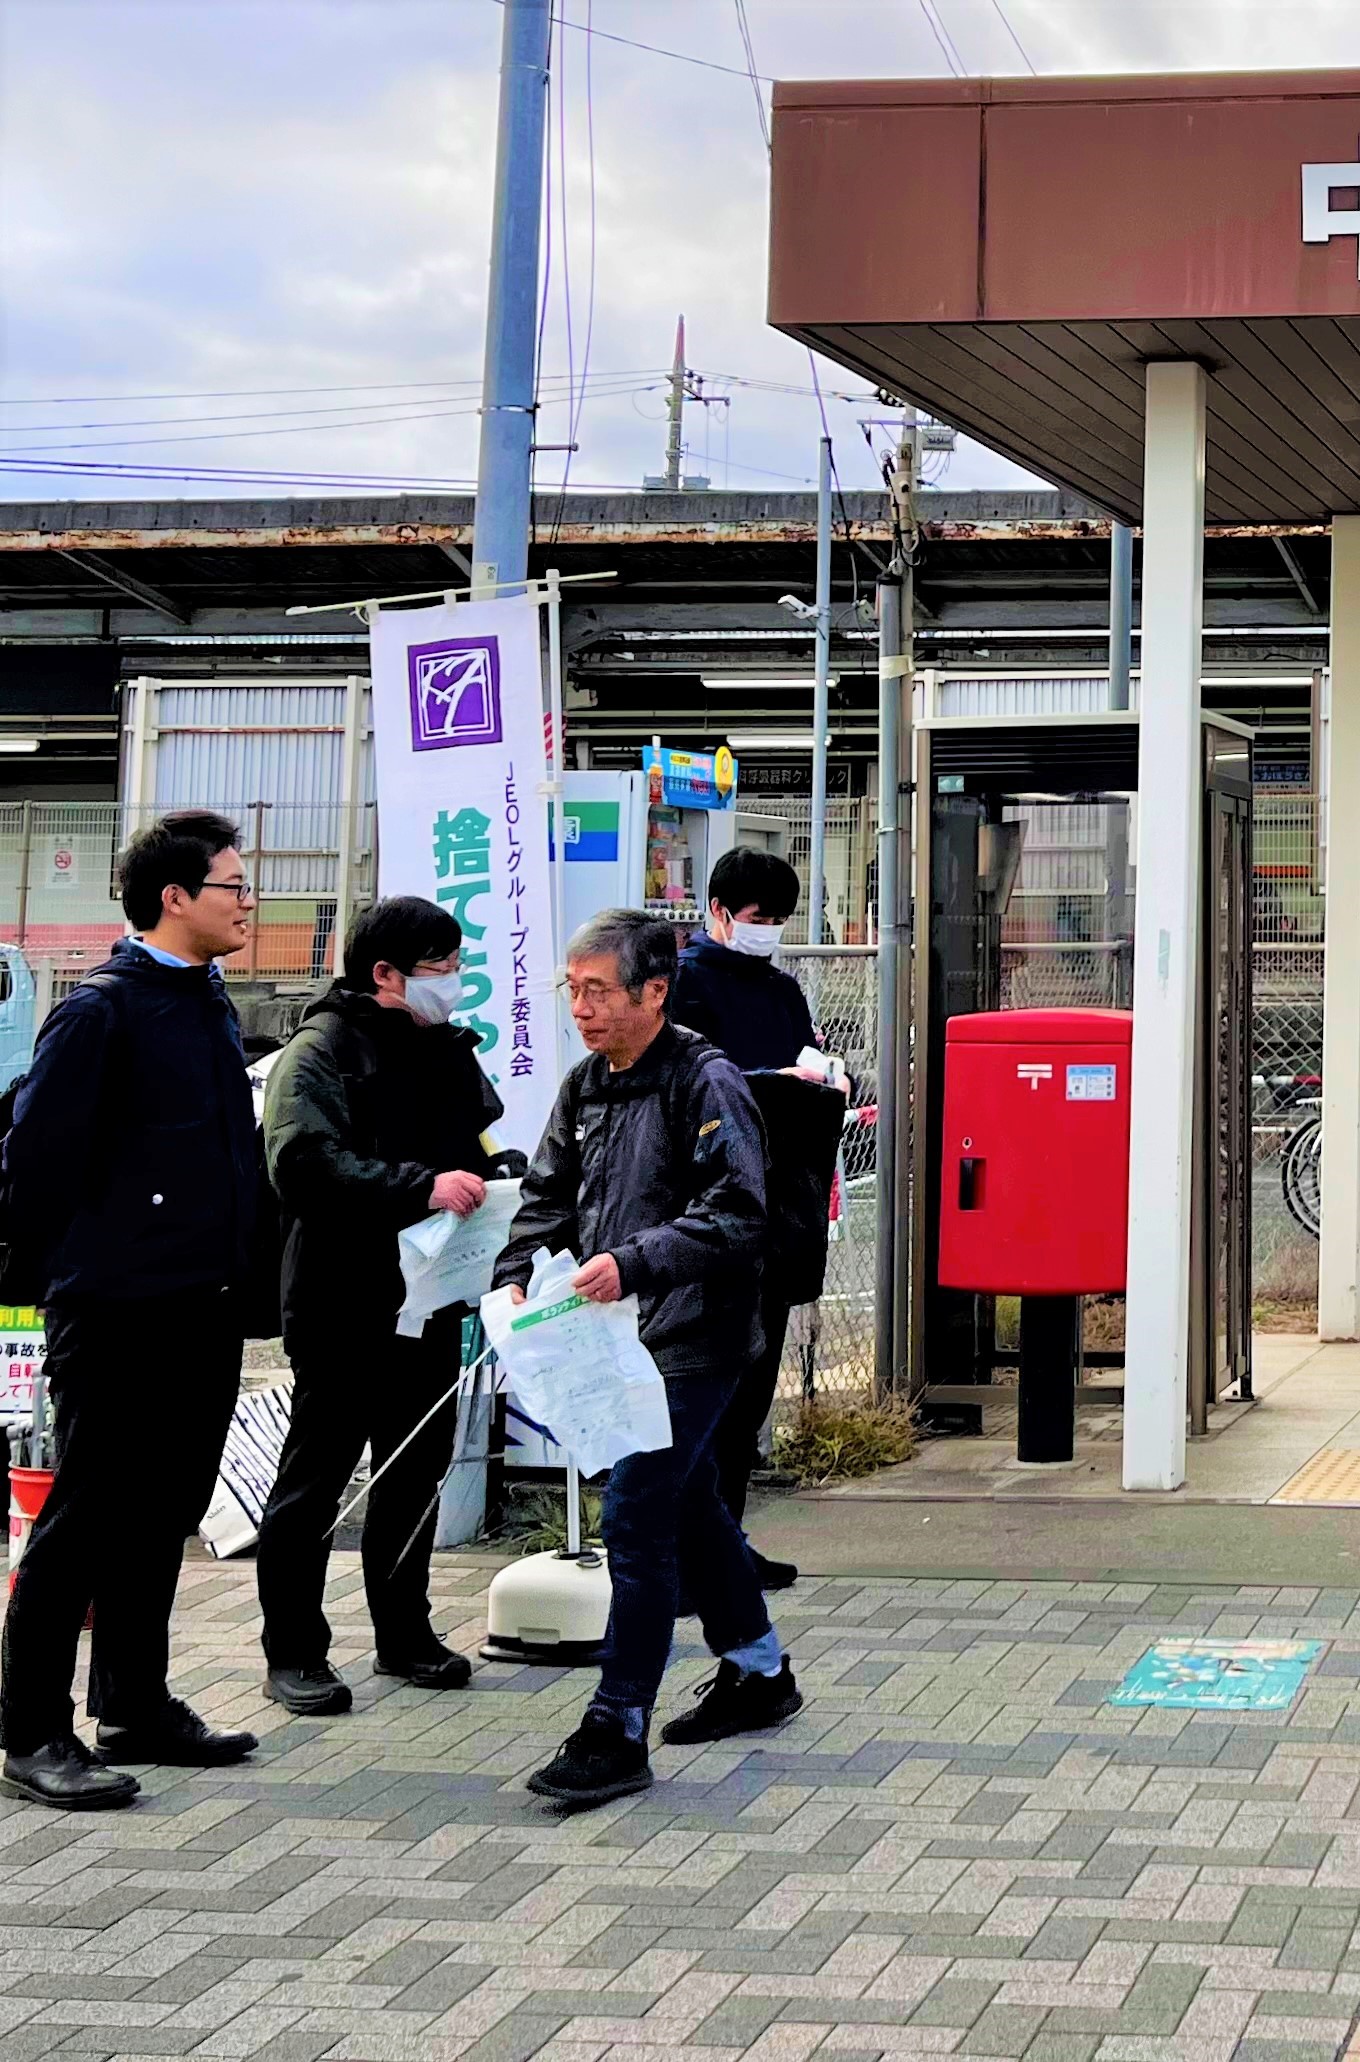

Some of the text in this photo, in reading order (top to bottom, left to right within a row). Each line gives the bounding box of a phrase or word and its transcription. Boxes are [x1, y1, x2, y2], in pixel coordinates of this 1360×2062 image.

[433, 805, 500, 1084] 捨てちゃ
[505, 761, 533, 1077] JEOLグループKF委員会
[0, 1342, 49, 1358] 事故を
